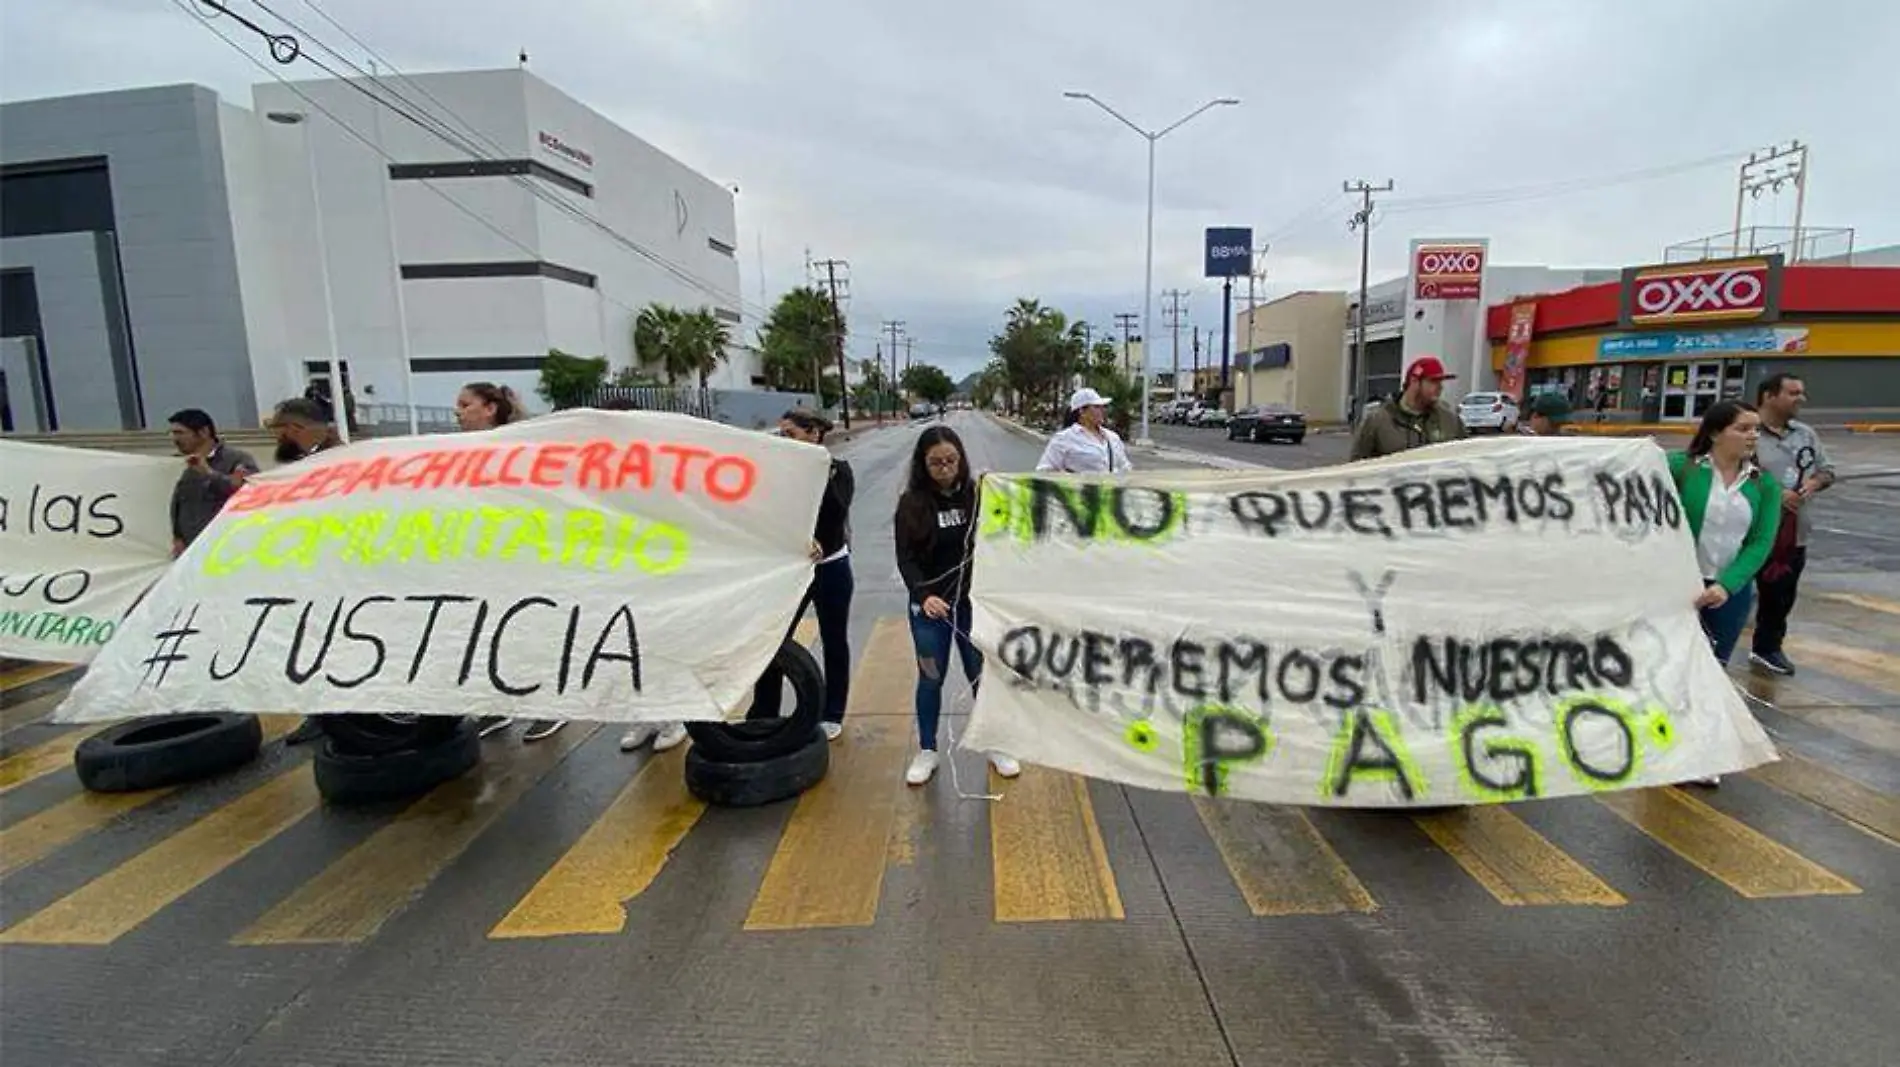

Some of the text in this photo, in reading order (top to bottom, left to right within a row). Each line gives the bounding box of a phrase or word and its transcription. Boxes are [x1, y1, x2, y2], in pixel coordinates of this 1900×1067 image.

[1422, 252, 1479, 274] OXXO
[1637, 267, 1762, 316] OXXO
[228, 440, 757, 512] EBACHILLERATO
[1027, 477, 1178, 540] NO
[1229, 473, 1575, 537] QUEREMOS
[29, 484, 124, 539] las
[203, 504, 690, 577] COMUNITARIO
[0, 611, 115, 645] NITARIO
[1346, 568, 1399, 635] Y
[998, 625, 1634, 706] QUEREMOS NUESTRO
[1185, 700, 1638, 799] PAGO
